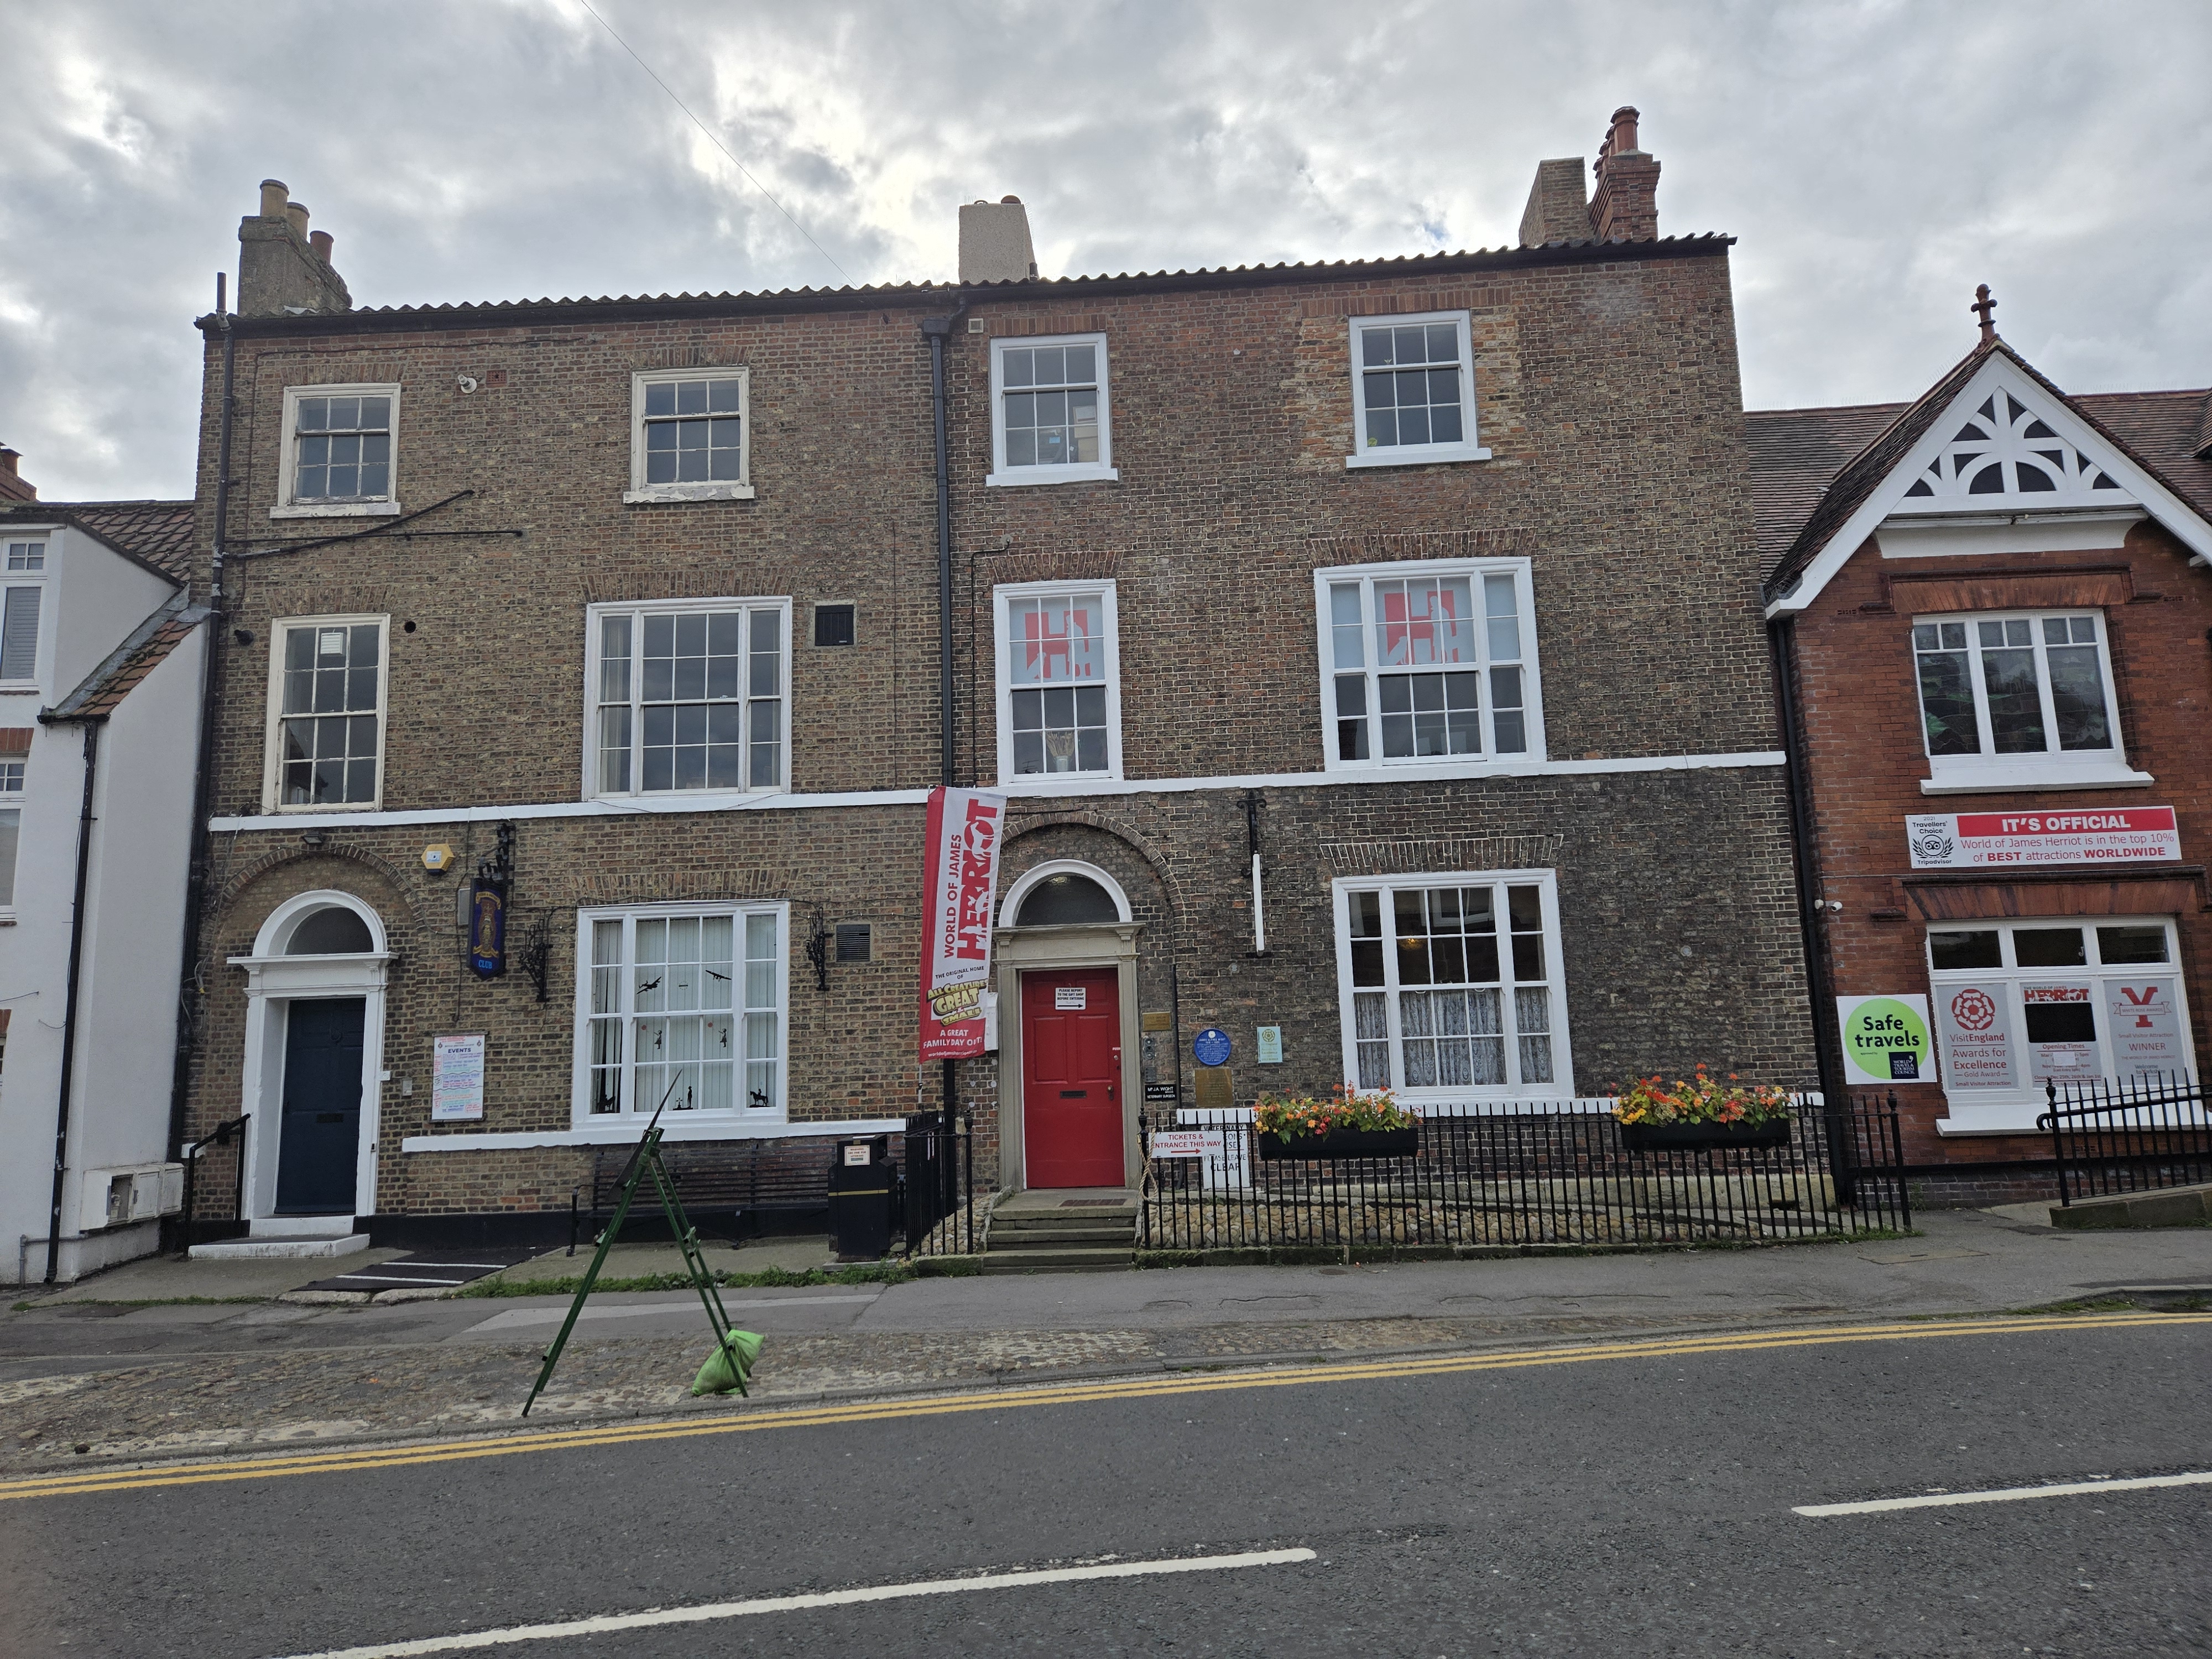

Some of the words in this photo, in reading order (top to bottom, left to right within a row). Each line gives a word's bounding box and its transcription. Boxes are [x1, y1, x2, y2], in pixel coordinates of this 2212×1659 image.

[2002, 818, 2041, 832] IT'S
[2046, 815, 2131, 830] OFFICIAL
[1961, 839, 1991, 849] World
[1995, 839, 2005, 848] of
[2009, 838, 2042, 848] James
[2046, 837, 2081, 847] Herriot
[2085, 836, 2093, 844] is
[2096, 836, 2106, 844] in
[2109, 835, 2127, 844] the
[2130, 834, 2147, 845] top
[2151, 833, 2174, 842] 10%
[948, 834, 962, 878] JAMES
[1973, 853, 1984, 862] of
[1987, 852, 2021, 862] BEST
[2026, 850, 2081, 860] attractions
[2084, 847, 2166, 858] WORLDWIDE
[957, 799, 998, 960] HERRIOT
[947, 882, 958, 901] OF
[945, 906, 957, 958] WORLD
[478, 960, 492, 969] CLUB
[946, 968, 969, 977] ORIGINAL
[935, 987, 979, 1014] GREAT
[942, 1008, 982, 1025] SMALL
[1863, 1014, 1903, 1031] Safe
[923, 1039, 950, 1049] FAMILY
[1855, 1030, 1920, 1047] travels
[2128, 1042, 2166, 1051] WINNER
[1953, 1048, 1990, 1058] Awards
[1992, 1047, 2006, 1057] for
[1954, 1060, 2007, 1070] Excellence
